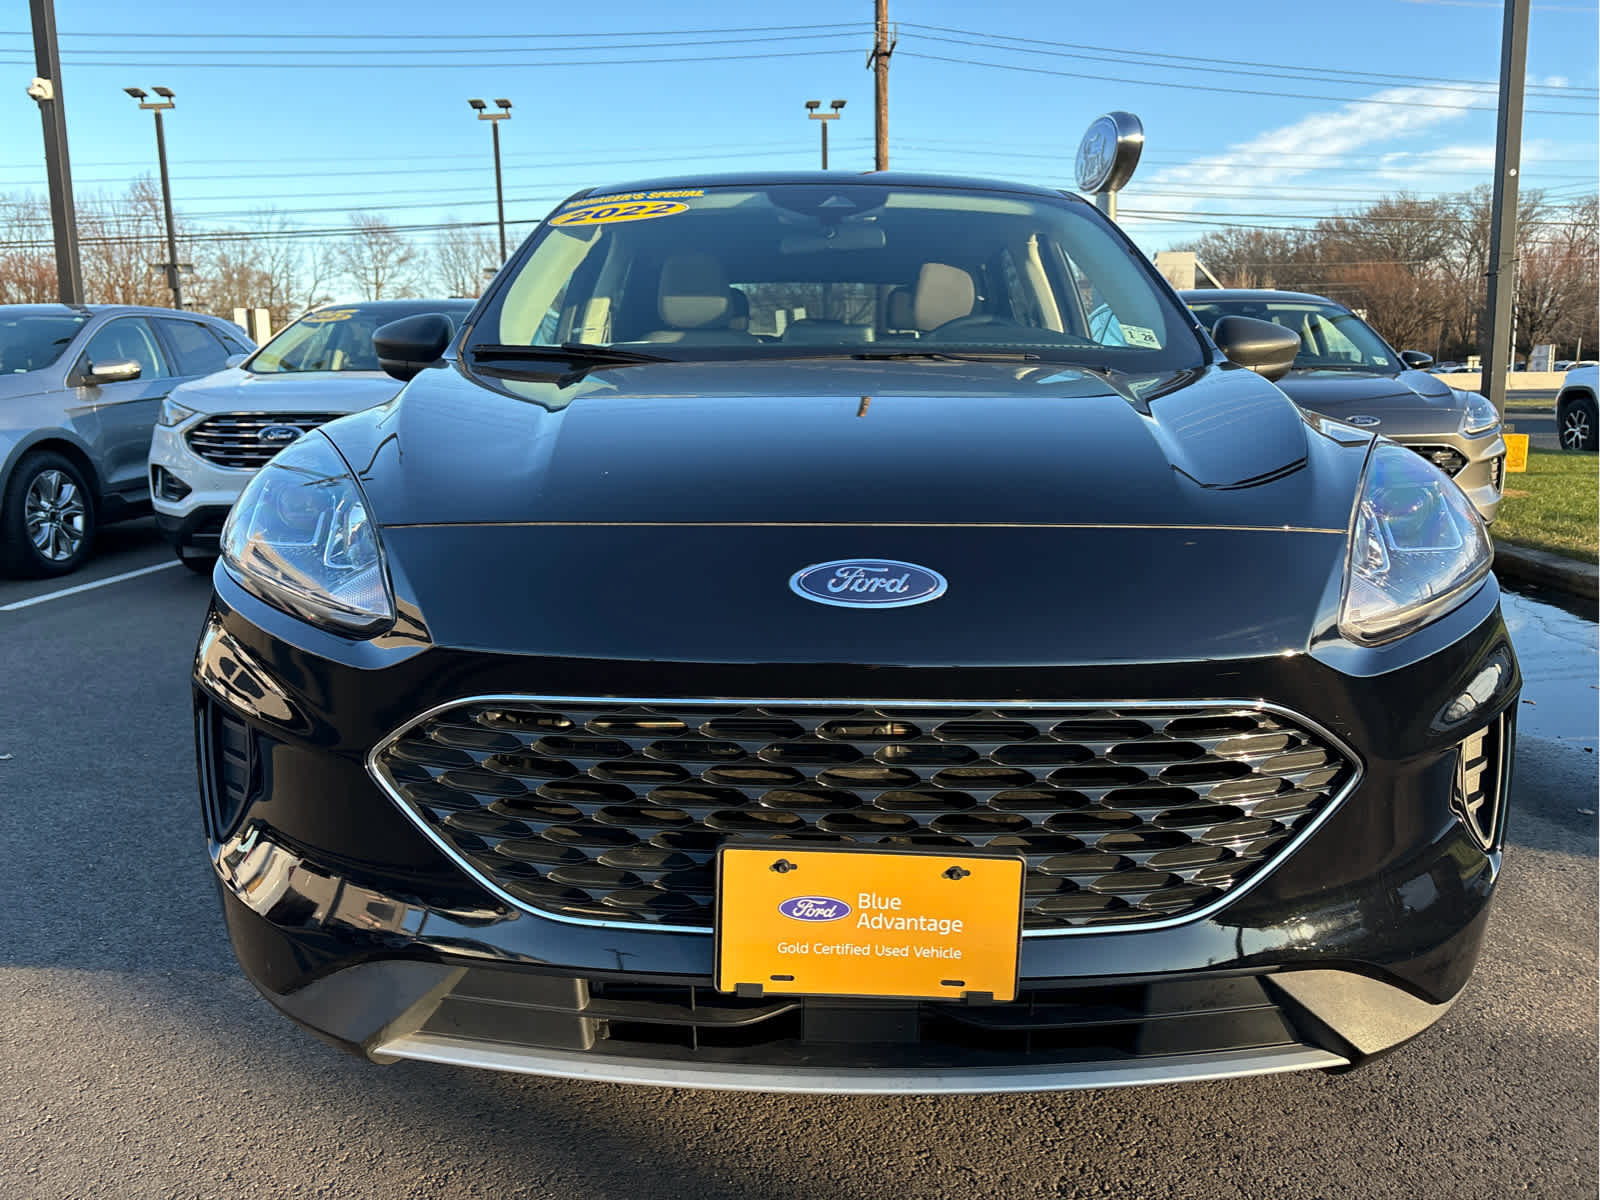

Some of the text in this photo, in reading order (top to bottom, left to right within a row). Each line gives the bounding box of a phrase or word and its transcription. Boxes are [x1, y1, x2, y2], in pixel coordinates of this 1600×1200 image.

[647, 189, 705, 199] SPECIAL
[560, 203, 677, 224] 2022
[827, 566, 910, 593] Ford
[791, 898, 837, 919] Ford
[857, 892, 902, 911] Blue
[856, 912, 963, 935] Advantage
[777, 941, 962, 960] Gold Certified Used Vehicle
